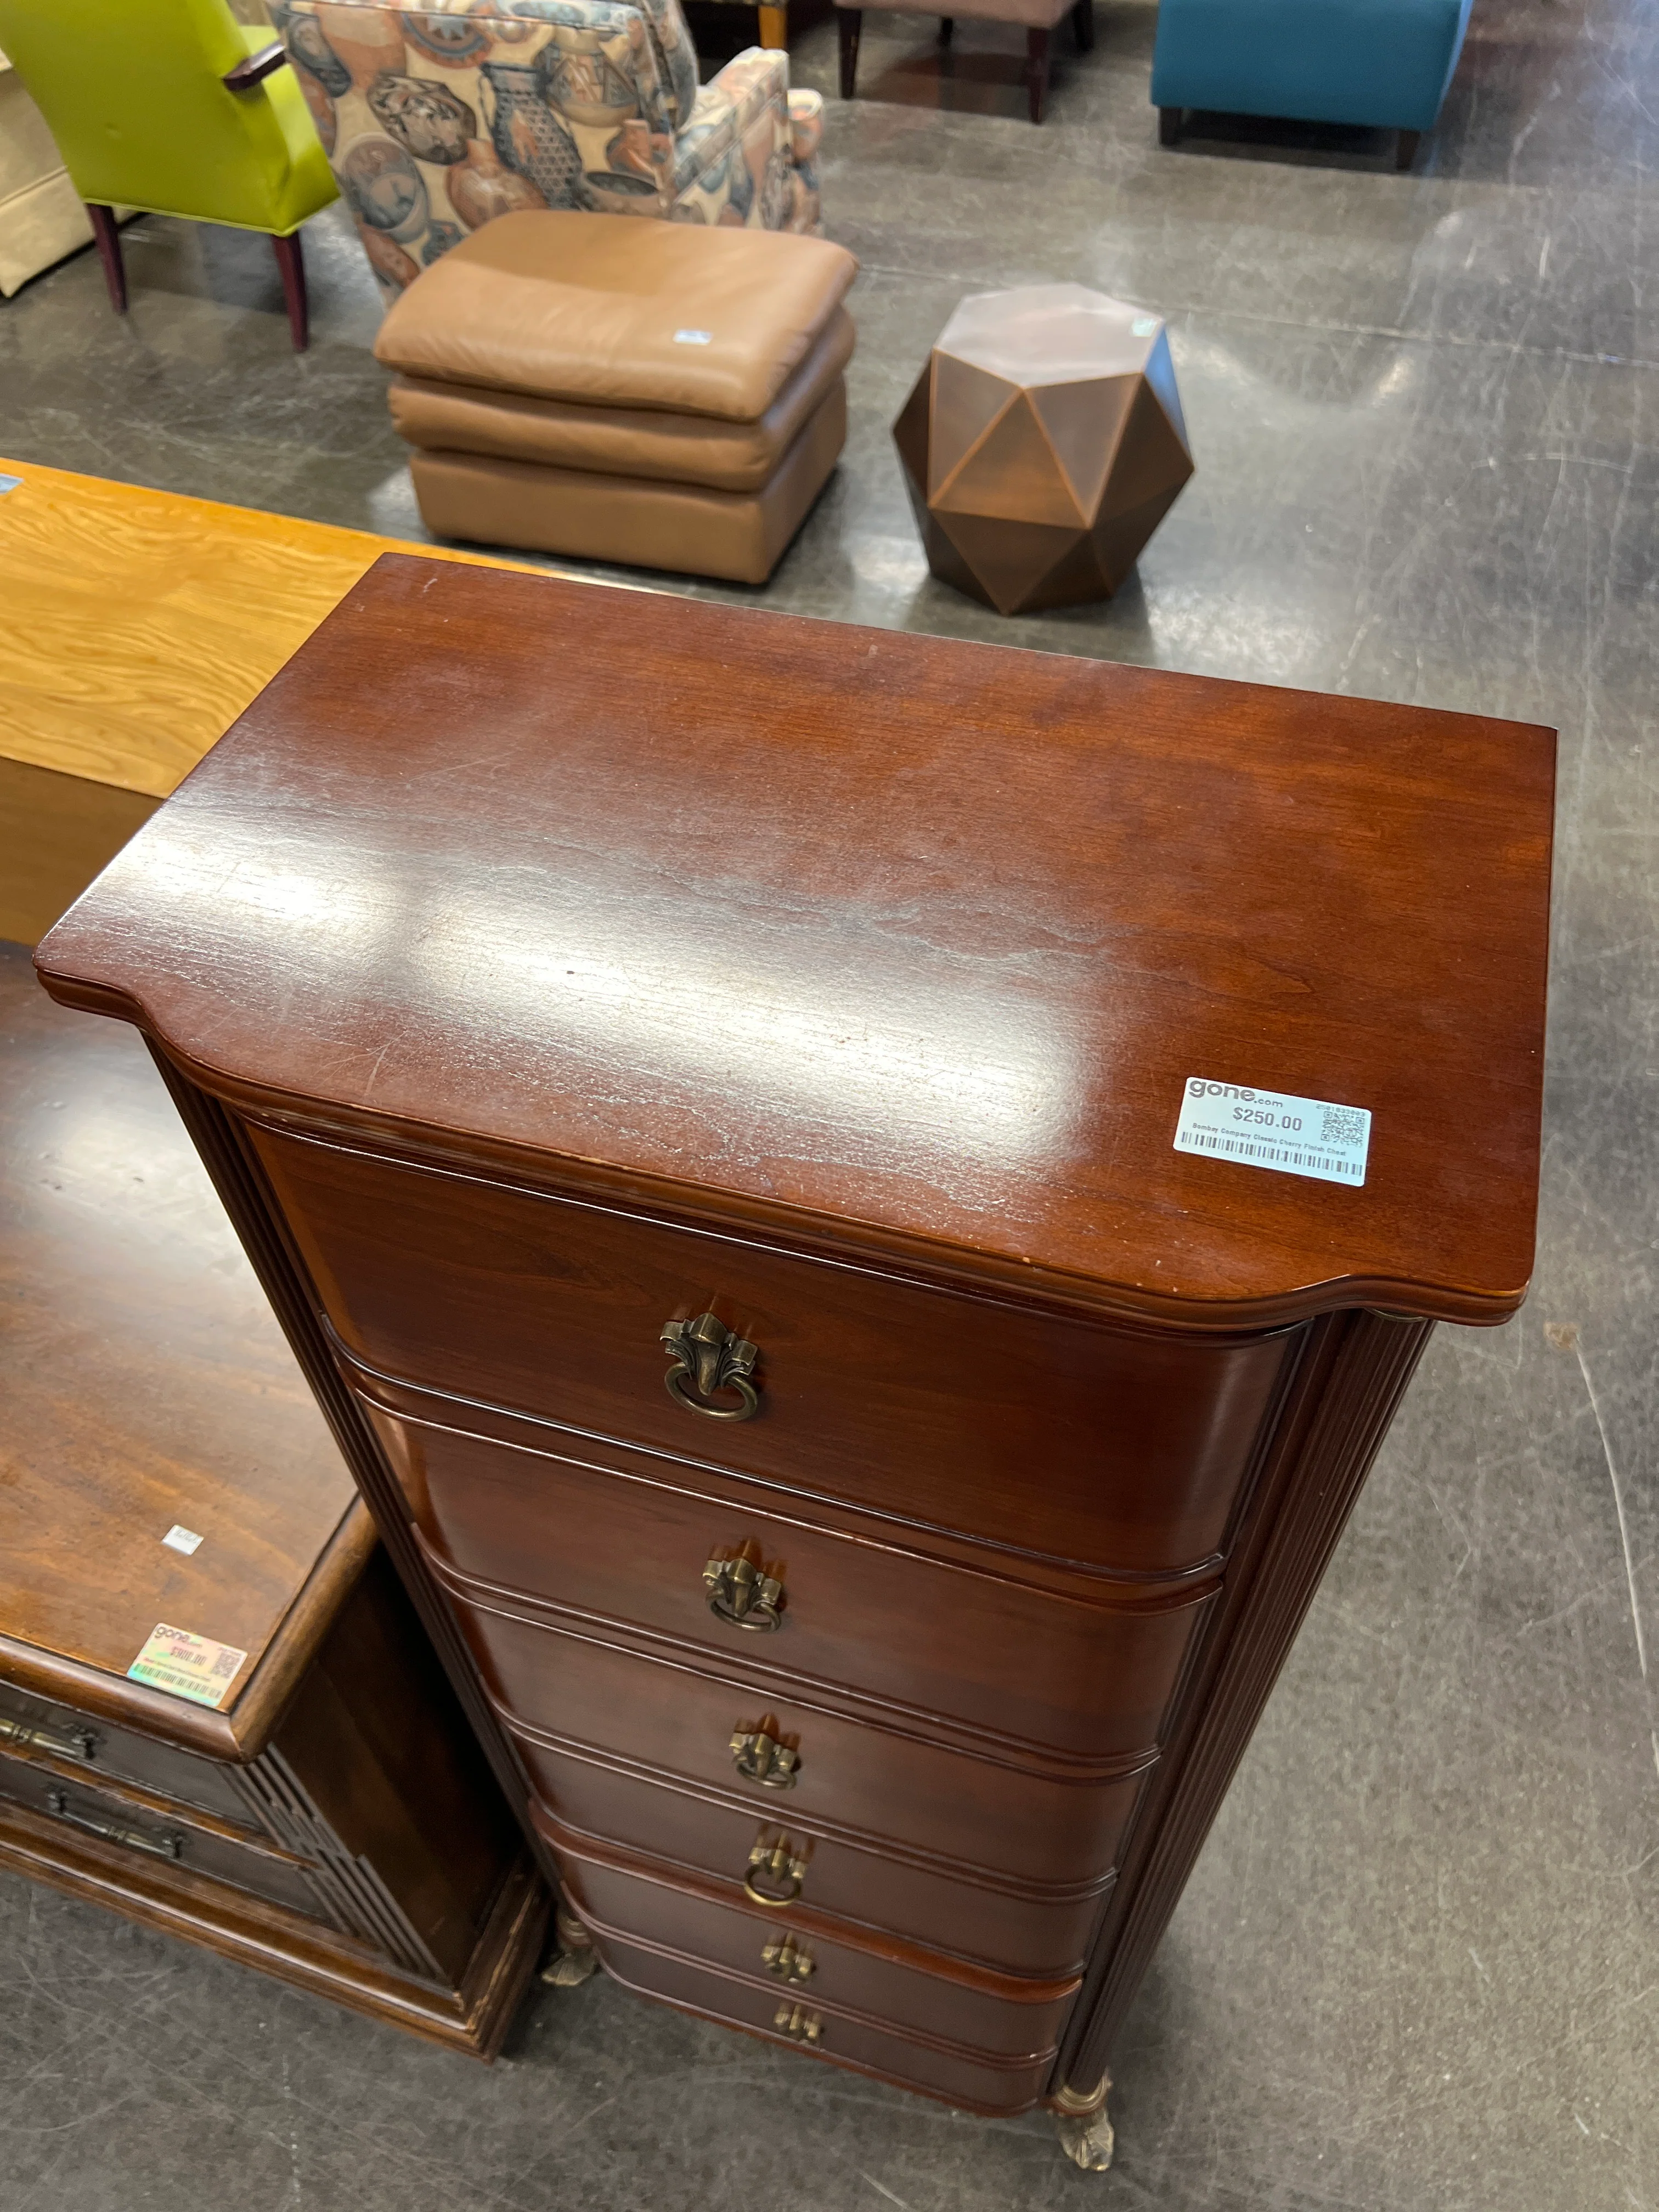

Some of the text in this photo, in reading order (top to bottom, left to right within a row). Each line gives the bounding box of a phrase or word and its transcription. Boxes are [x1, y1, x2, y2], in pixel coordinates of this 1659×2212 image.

[1232, 1106, 1302, 1131] $250.00
[1192, 1122, 1346, 1156] Bombay Company Classic Cherry Finish Chest
